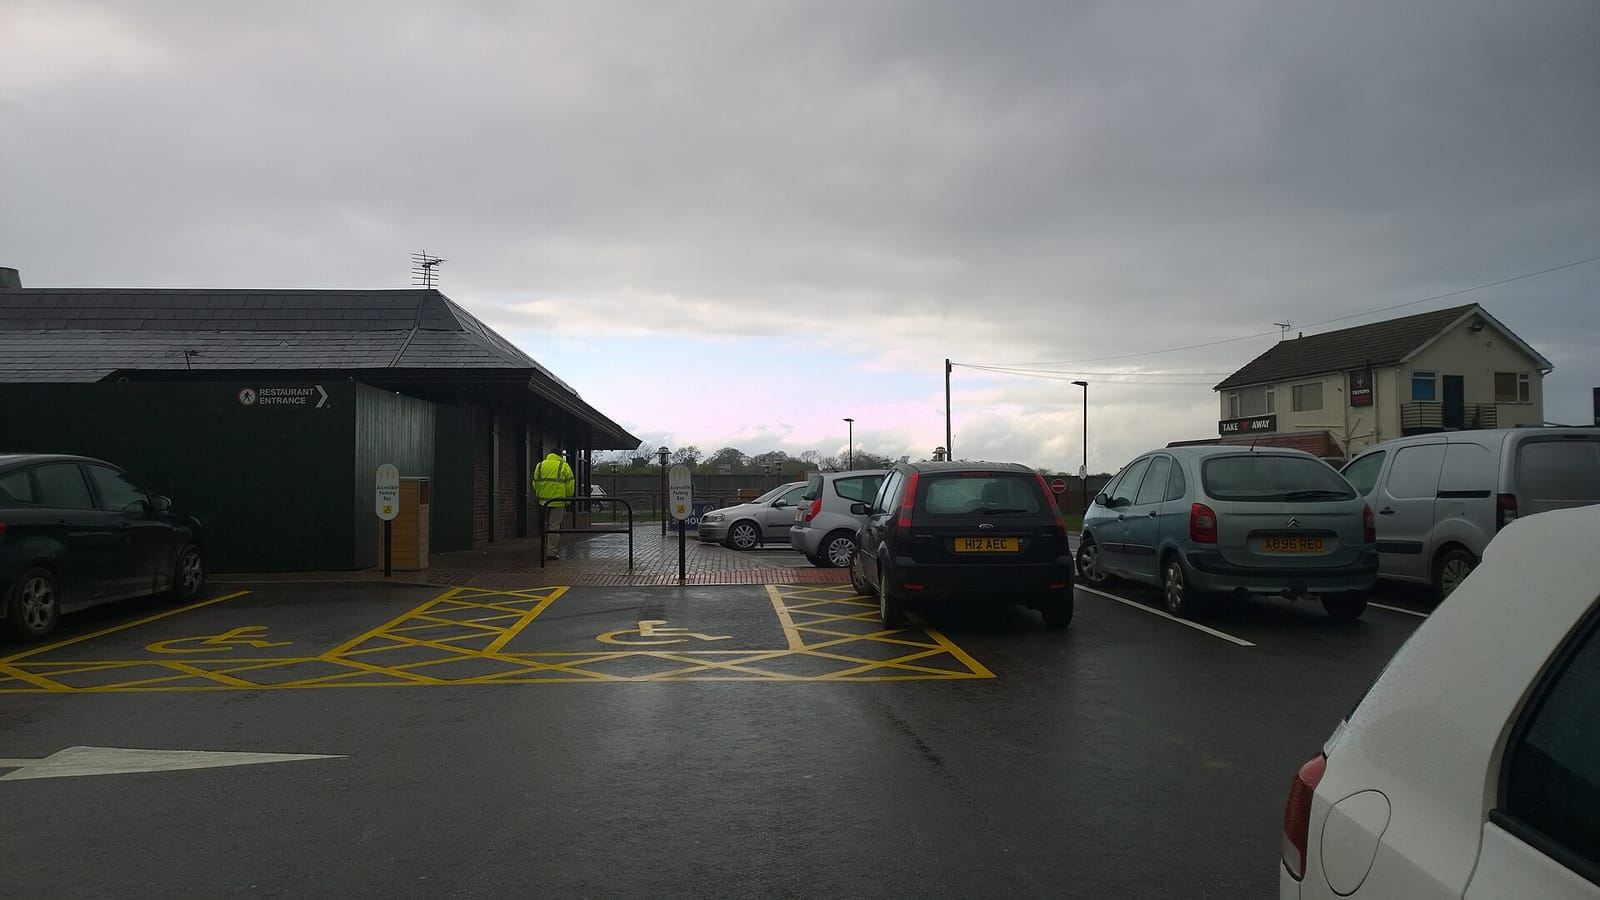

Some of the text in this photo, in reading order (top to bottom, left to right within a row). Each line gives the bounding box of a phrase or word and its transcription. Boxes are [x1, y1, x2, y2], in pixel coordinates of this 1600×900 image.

[260, 388, 314, 396] RESTAURANT
[260, 397, 306, 405] ENTRANCE
[1222, 420, 1270, 432] TAKE AWAY
[965, 539, 1008, 549] H12 AEC
[1265, 539, 1297, 549] X896
